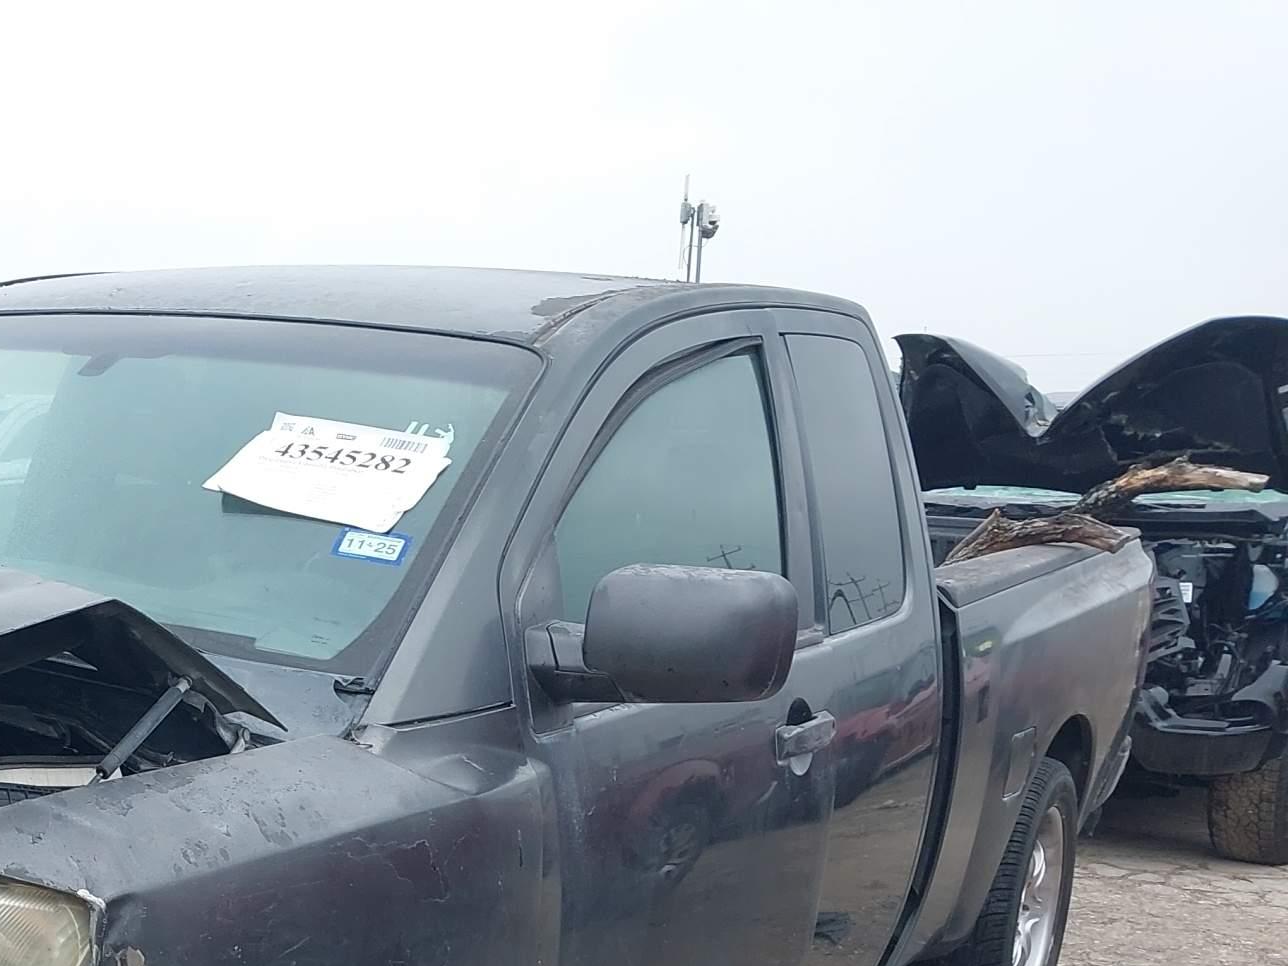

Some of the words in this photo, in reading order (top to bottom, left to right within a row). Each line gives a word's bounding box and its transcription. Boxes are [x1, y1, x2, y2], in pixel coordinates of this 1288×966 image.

[274, 442, 412, 474] 43545282
[347, 538, 366, 550] 11
[373, 542, 399, 556] 25
